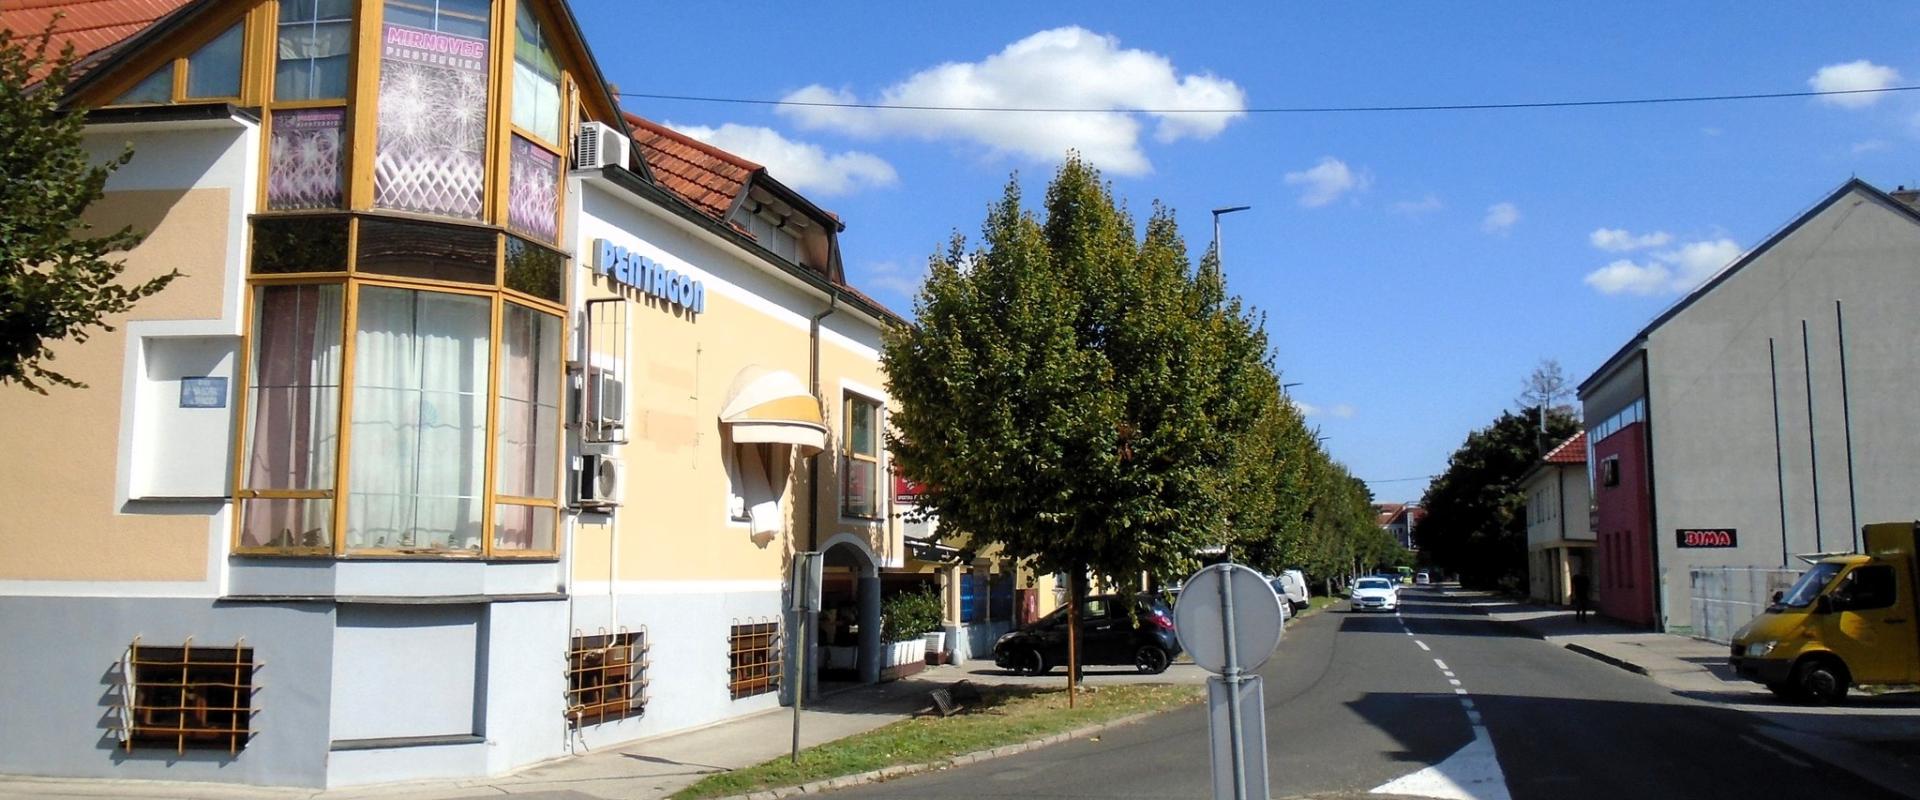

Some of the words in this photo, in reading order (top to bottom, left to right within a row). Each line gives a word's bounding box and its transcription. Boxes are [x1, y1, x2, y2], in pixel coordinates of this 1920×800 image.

[388, 27, 484, 58] MIRNOVEC
[594, 238, 705, 314] PENTAGON
[1684, 530, 1731, 546] BIMA
